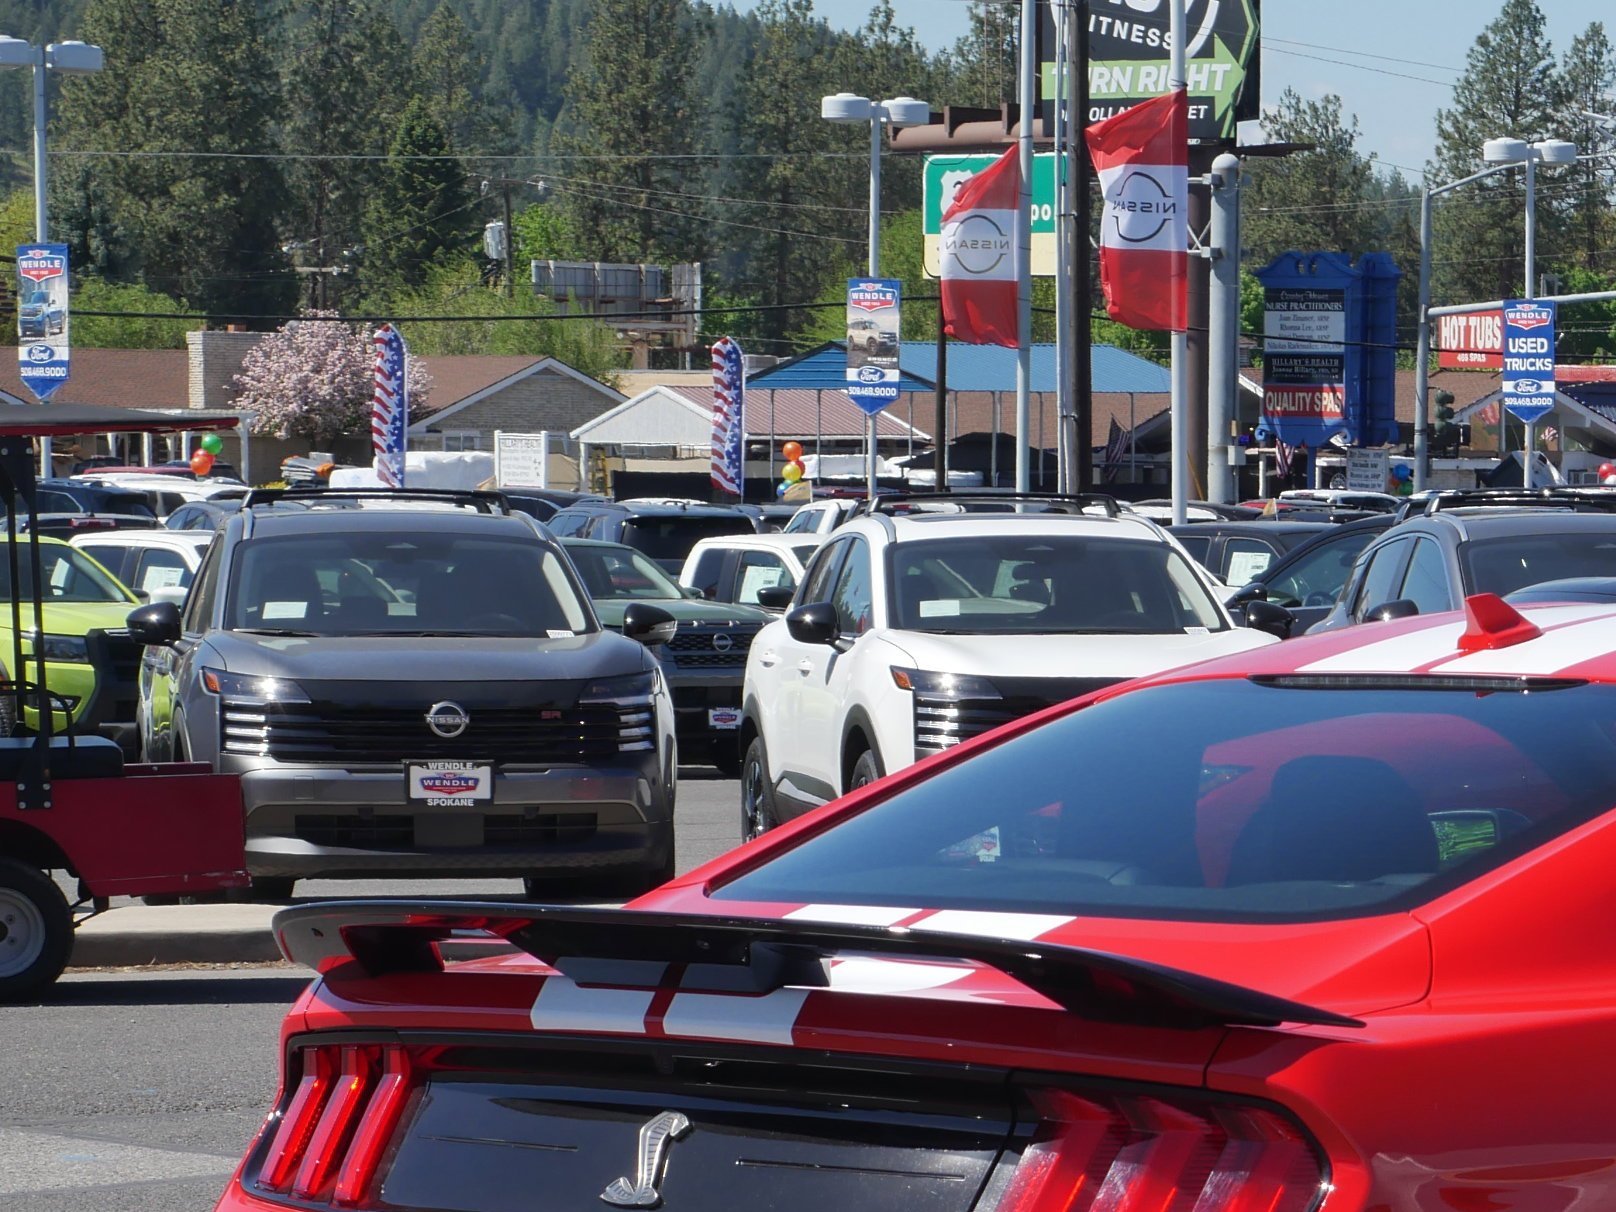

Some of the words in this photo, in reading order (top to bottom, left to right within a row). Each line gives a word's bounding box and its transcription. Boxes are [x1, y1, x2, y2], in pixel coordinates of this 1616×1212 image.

[1089, 14, 1171, 50] ITNESS
[20, 259, 61, 269] WENDLE
[851, 292, 893, 300] WENDLE
[1266, 302, 1288, 311] NURSE
[1290, 302, 1343, 311] PRACTITIONERS
[1508, 311, 1548, 319] WENDLE
[1440, 315, 1467, 350] HOT
[1468, 315, 1502, 350] TUBS
[1508, 337, 1548, 354] USED
[1504, 358, 1552, 371] TRUCKS
[1265, 391, 1312, 412] QUALITY
[1314, 391, 1342, 413] SPAS
[426, 716, 470, 724] NISSAN
[427, 762, 473, 770] WENDLE
[427, 799, 475, 807] SPOKANE
